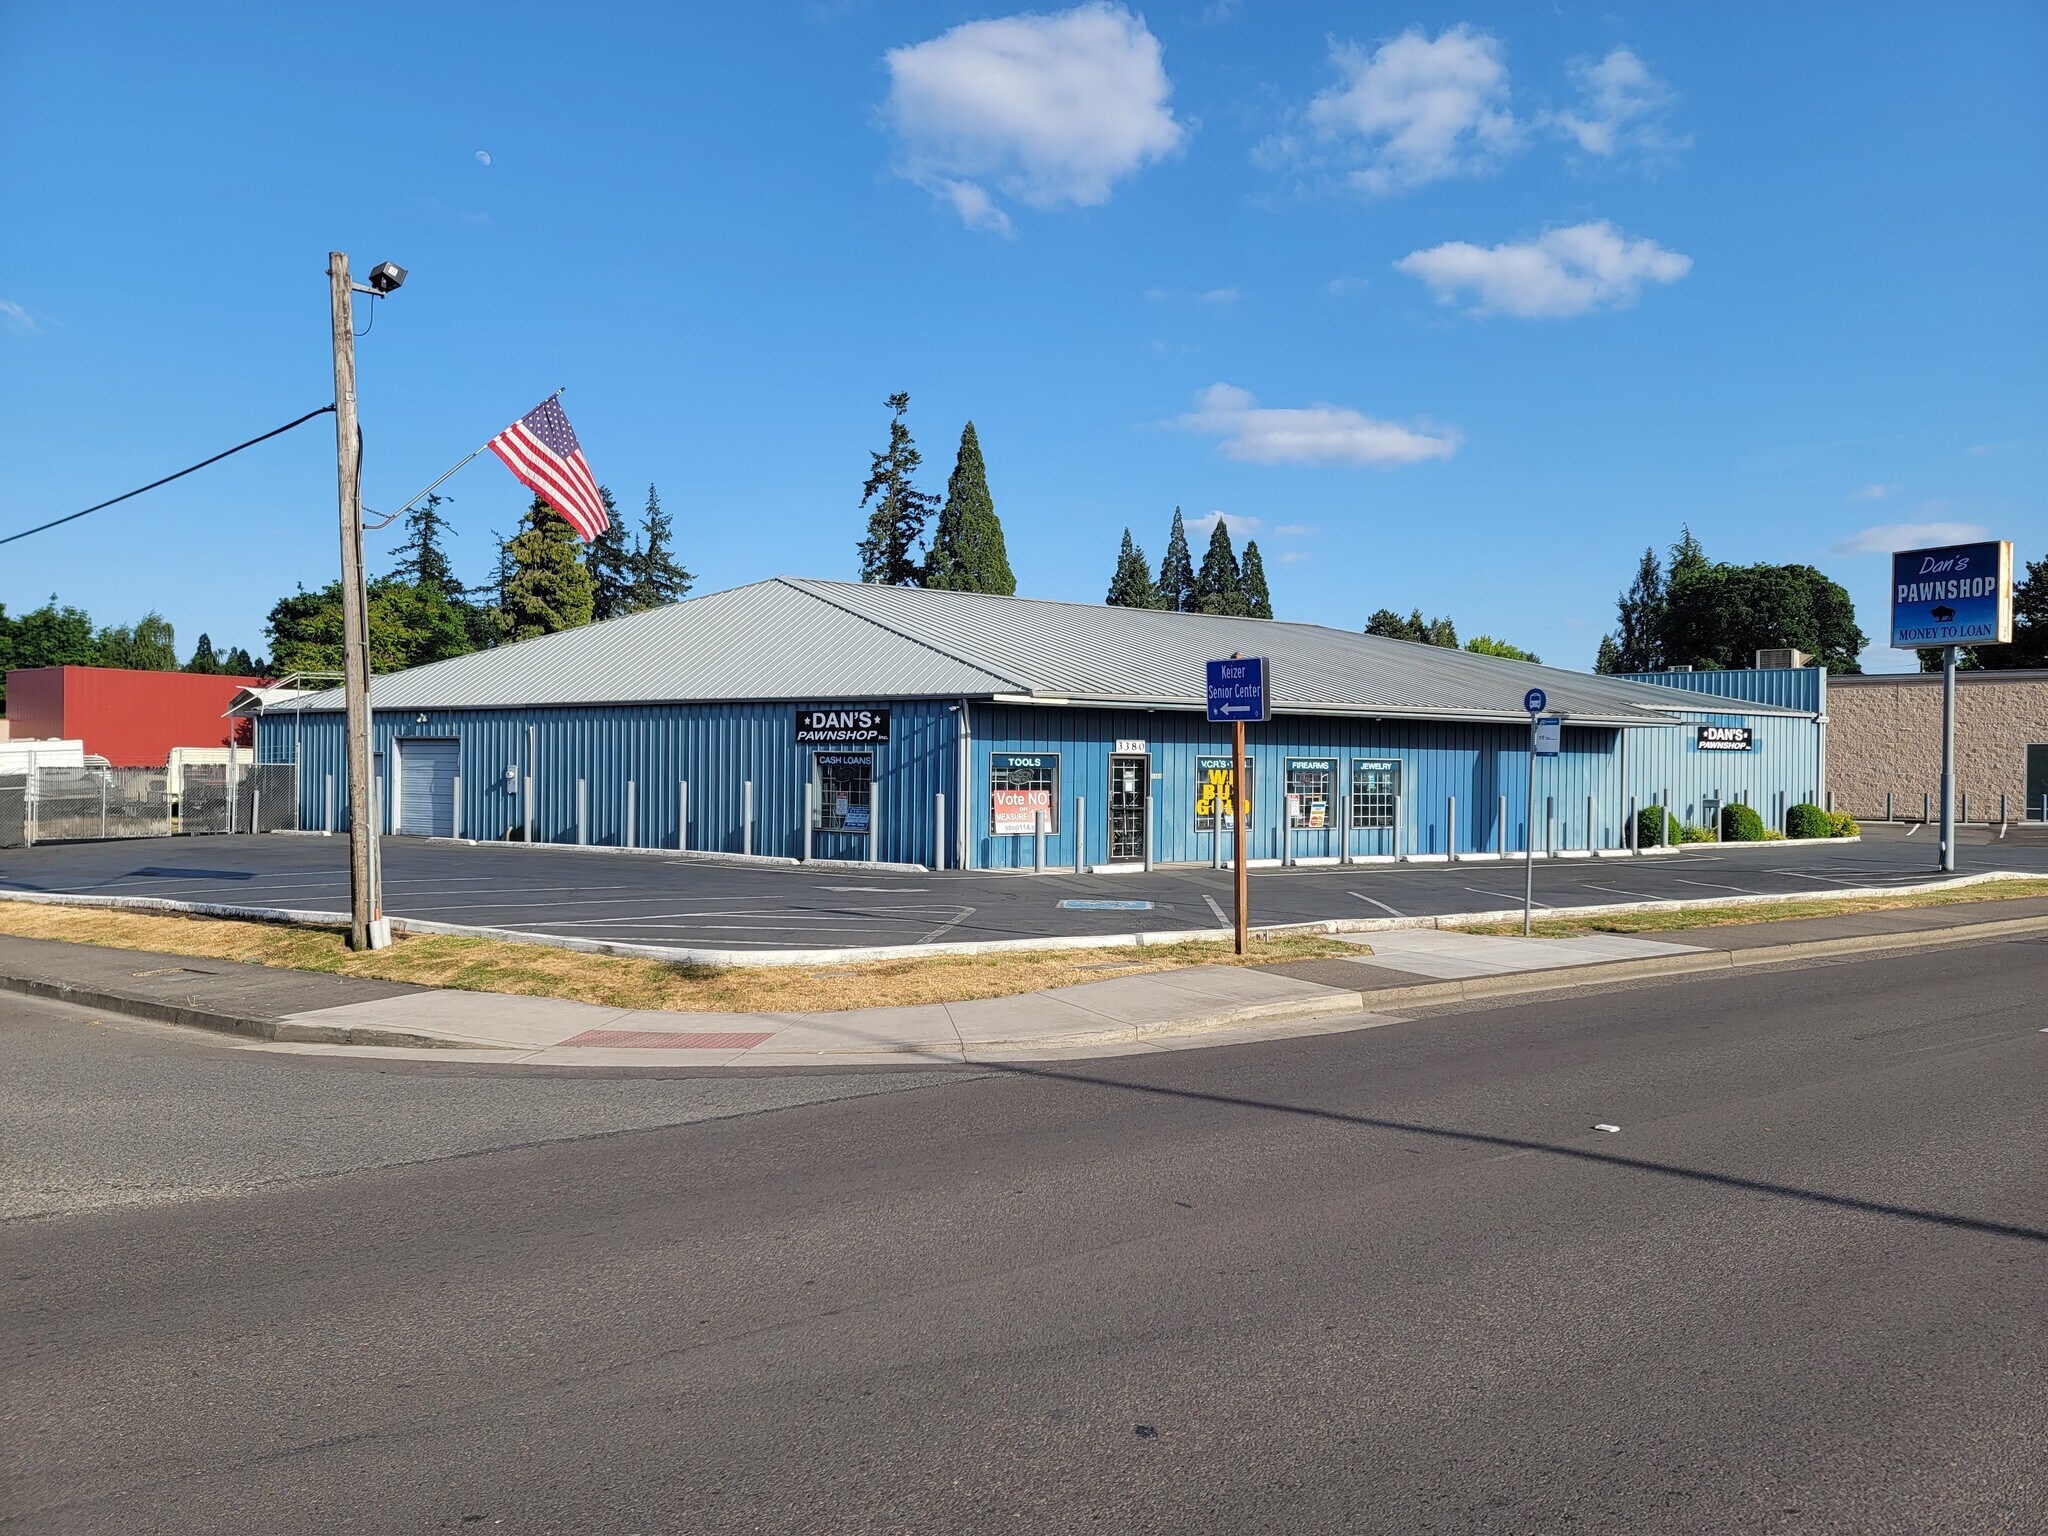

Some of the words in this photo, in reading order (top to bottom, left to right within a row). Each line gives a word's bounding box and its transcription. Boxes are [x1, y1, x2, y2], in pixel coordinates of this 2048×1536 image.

[1919, 554, 1970, 575] Dan's
[1897, 576, 1996, 604] PAWNSHOP
[1899, 627, 1939, 641] MONEY
[1941, 625, 1957, 638] TO
[1960, 623, 1992, 637] LOAN
[1221, 664, 1246, 679] Keizer
[1208, 684, 1233, 699] Senior
[1234, 683, 1260, 698] Center
[812, 711, 872, 729] DAN'S
[797, 730, 878, 741] PAWNSHOP
[1708, 727, 1744, 741] DAN'S
[1117, 741, 1145, 751] 3380
[1698, 741, 1746, 750] PAWNSHOP
[819, 756, 842, 764] CASH
[843, 756, 872, 765] LOANS
[1008, 758, 1041, 767] TOOLS
[1292, 761, 1329, 770] FIREARMS
[1360, 762, 1392, 770] JEWELRY
[996, 792, 1025, 806] Vote
[1028, 792, 1048, 805] NO
[996, 813, 1028, 821] MEASURE
